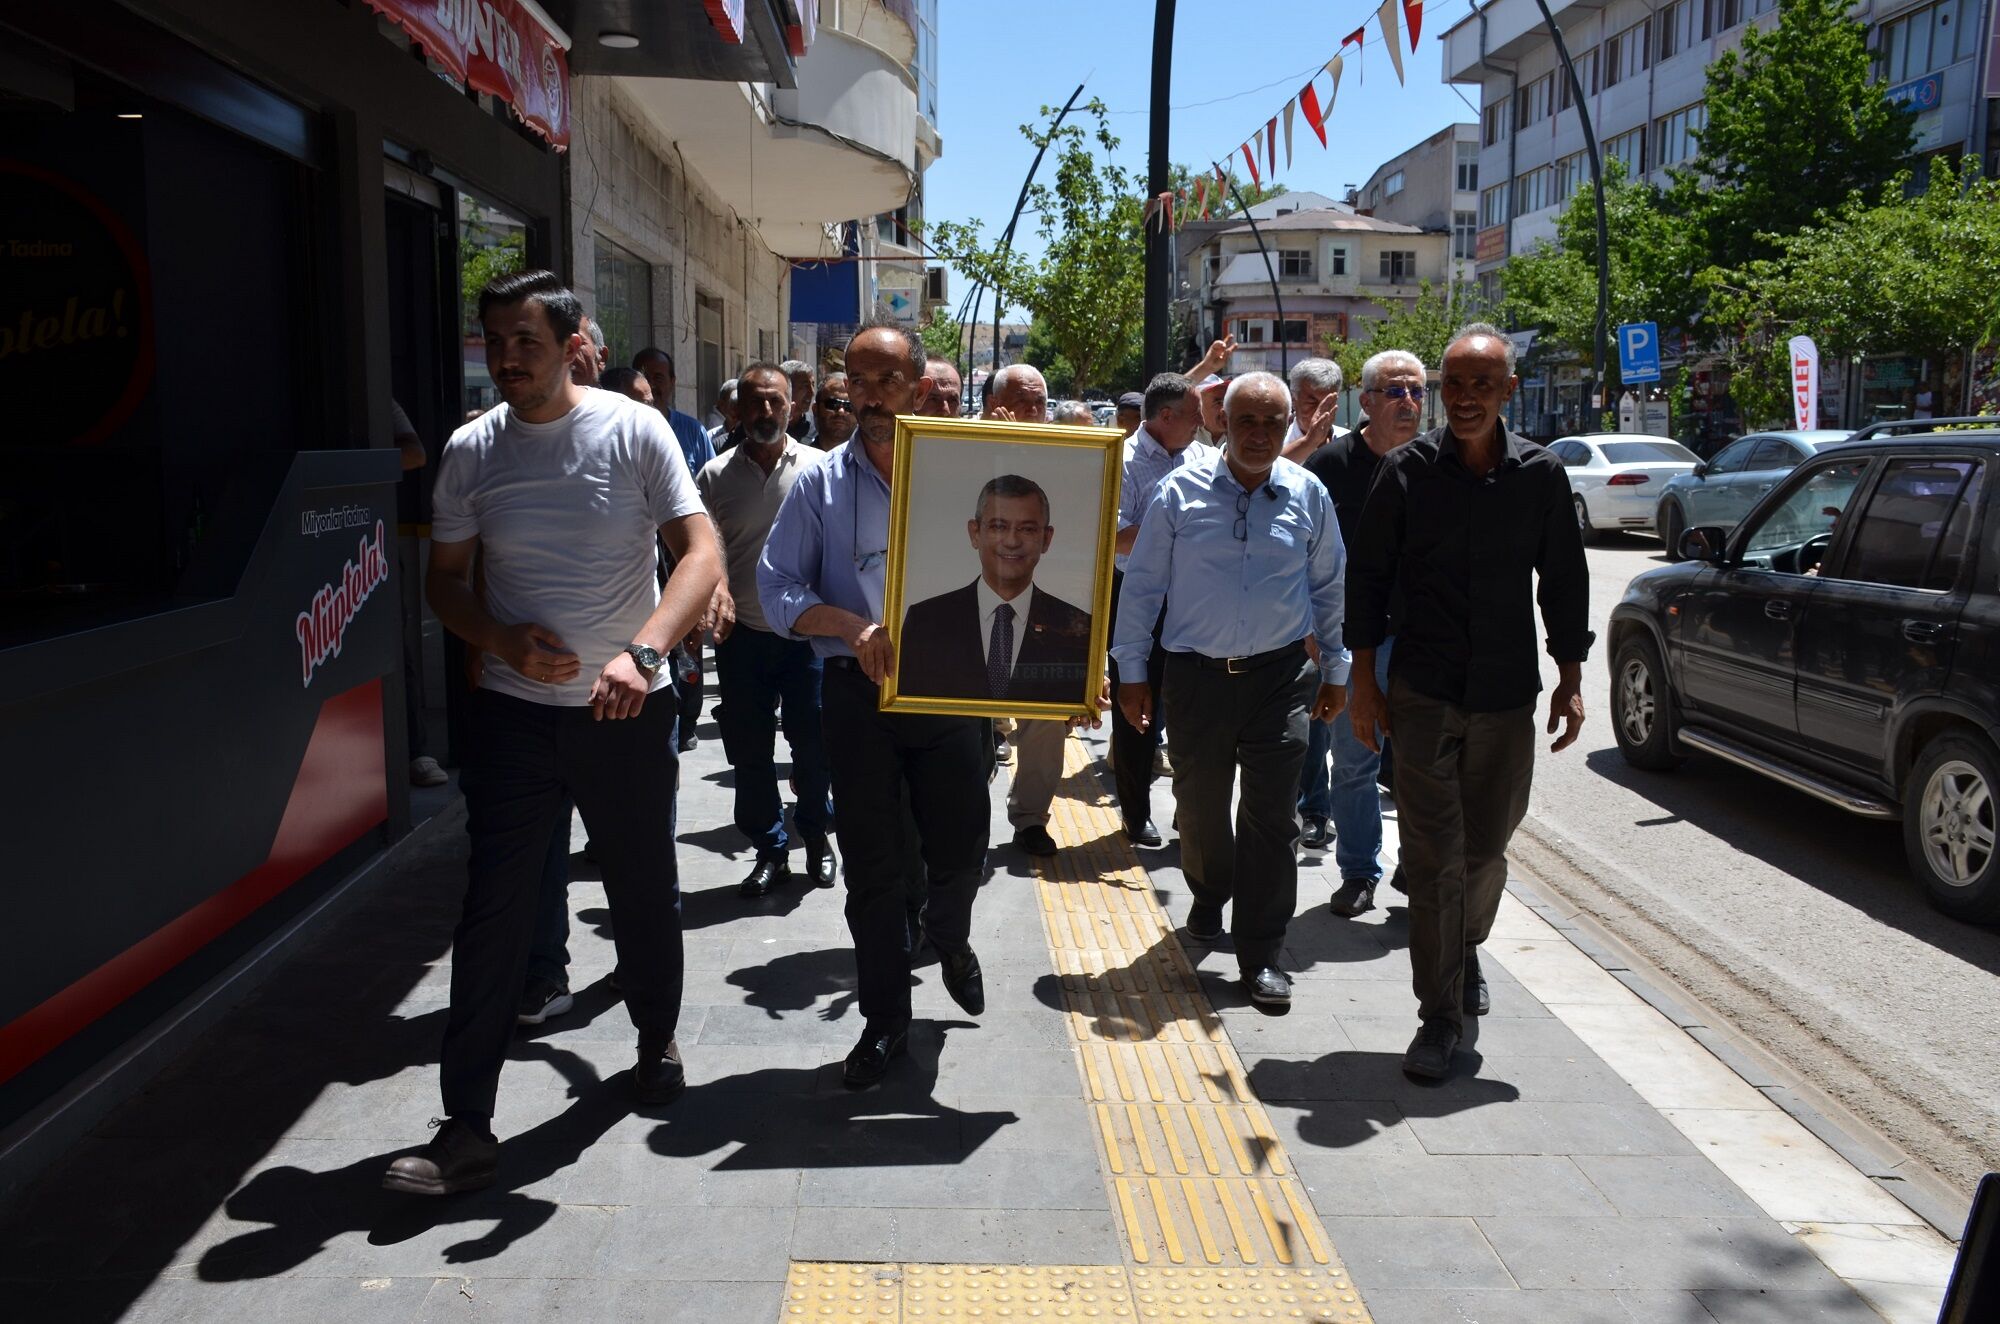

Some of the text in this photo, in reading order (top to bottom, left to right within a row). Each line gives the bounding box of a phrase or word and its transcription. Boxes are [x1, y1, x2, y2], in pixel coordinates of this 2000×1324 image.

[1627, 328, 1649, 360] P
[302, 508, 344, 538] Milyonlar
[296, 518, 388, 688] Müptela!
